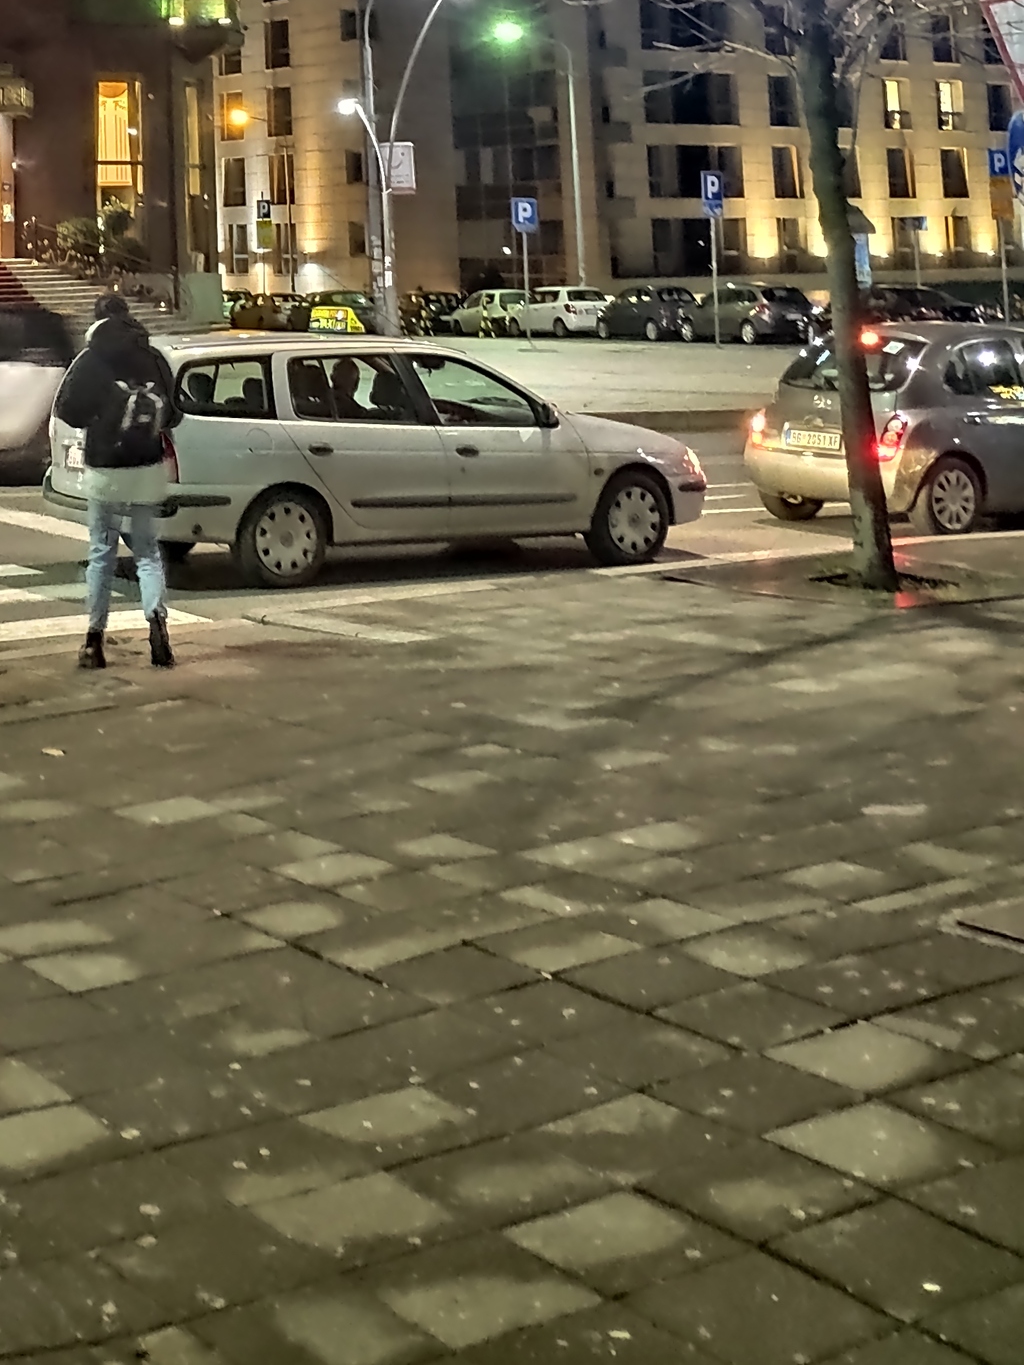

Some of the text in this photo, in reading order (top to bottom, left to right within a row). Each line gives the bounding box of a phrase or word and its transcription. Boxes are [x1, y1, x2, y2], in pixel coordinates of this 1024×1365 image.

[993, 153, 1006, 173] P
[707, 175, 719, 199] P
[260, 202, 268, 217] P
[518, 202, 533, 223] P
